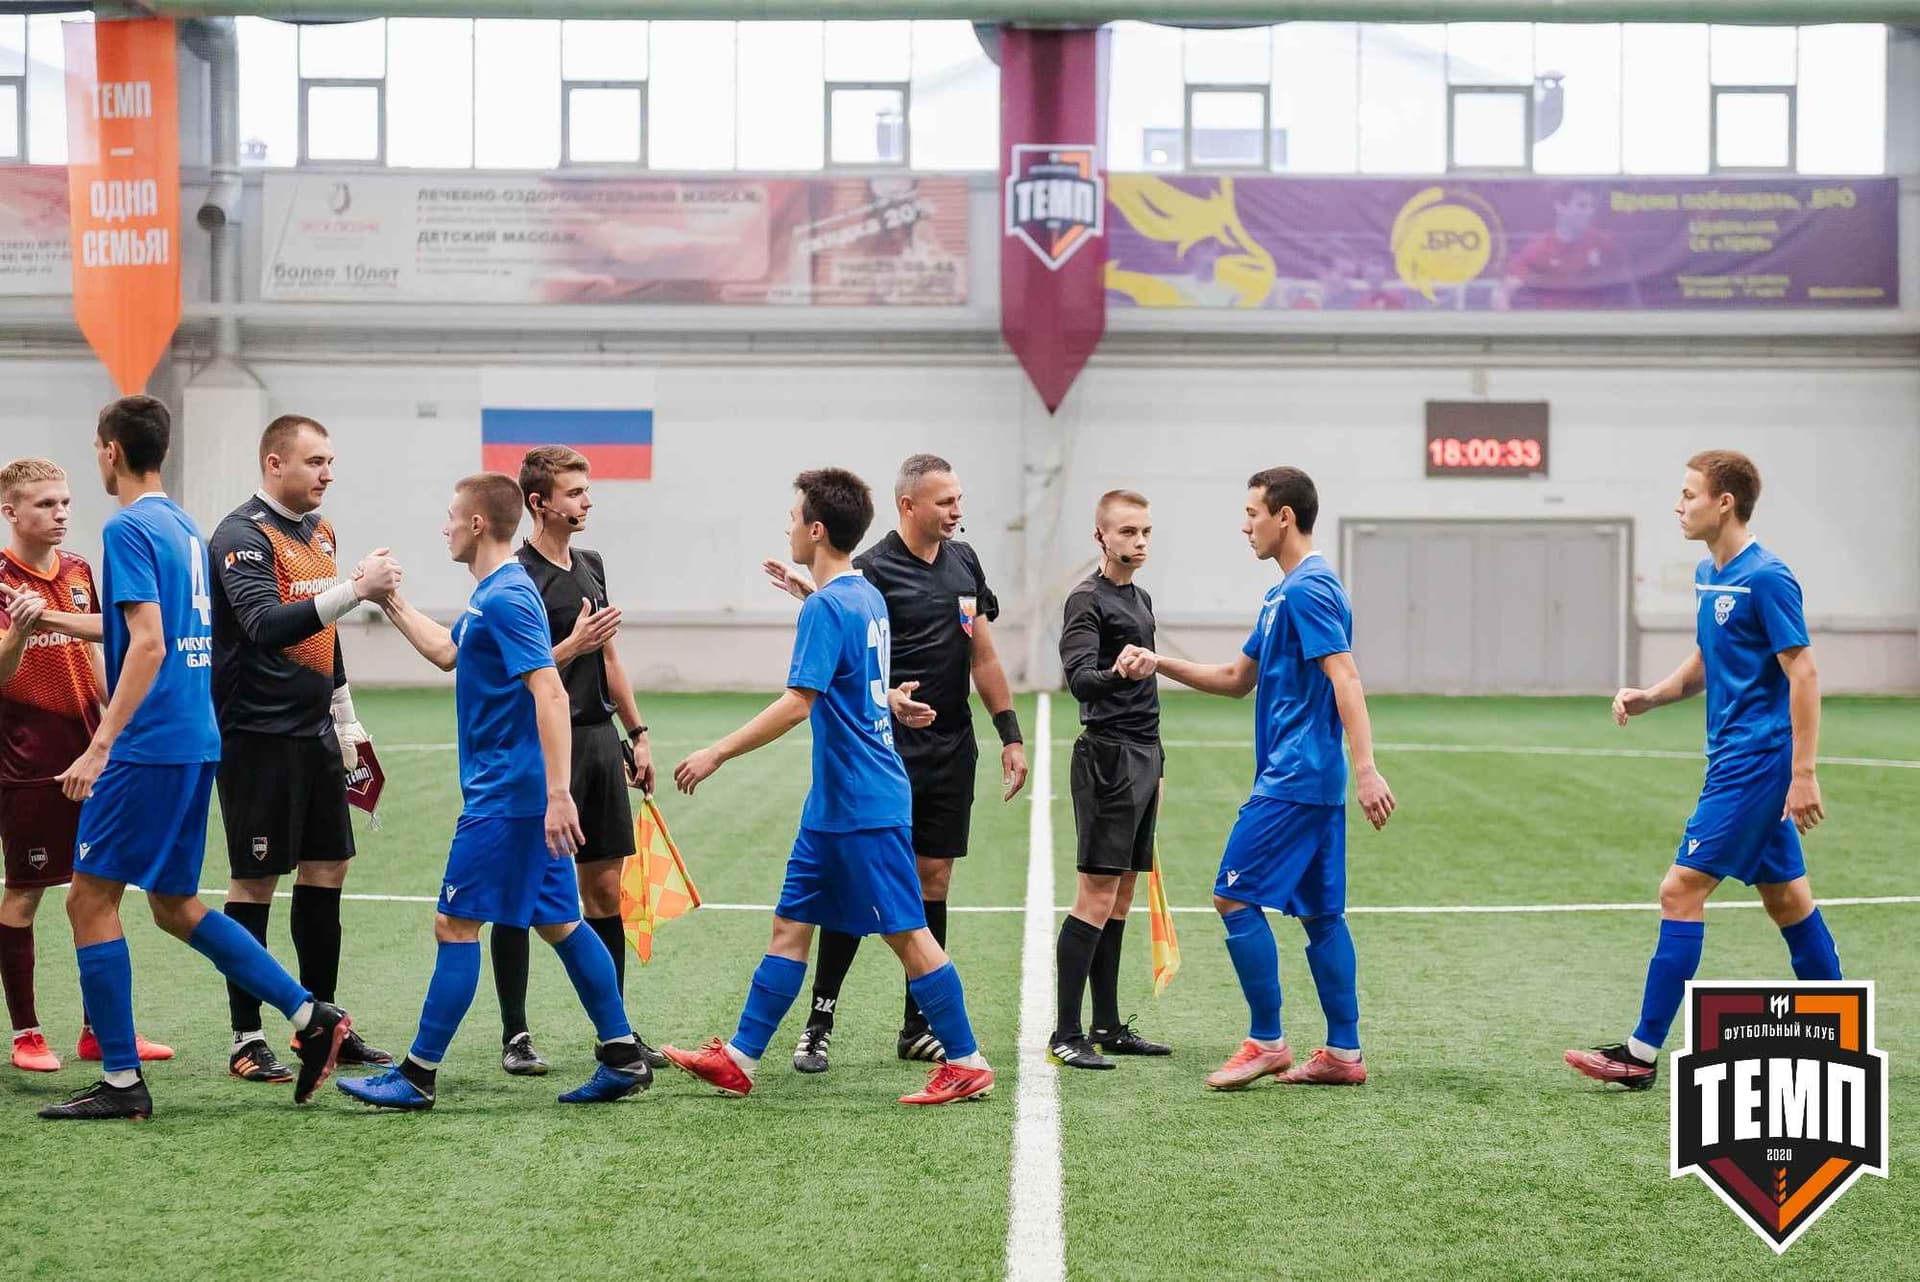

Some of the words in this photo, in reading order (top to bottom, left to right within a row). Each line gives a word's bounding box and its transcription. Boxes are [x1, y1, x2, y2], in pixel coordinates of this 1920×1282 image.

[90, 81, 152, 119] ТЕМП
[90, 179, 158, 223] ОДНА
[1015, 180, 1094, 222] ТЕМП
[82, 228, 169, 267] СЕМЬЯ!
[1429, 438, 1541, 467] 18:00:33
[236, 550, 263, 561] ПСБ
[190, 535, 211, 626] 4
[345, 767, 370, 786] ТЕМП
